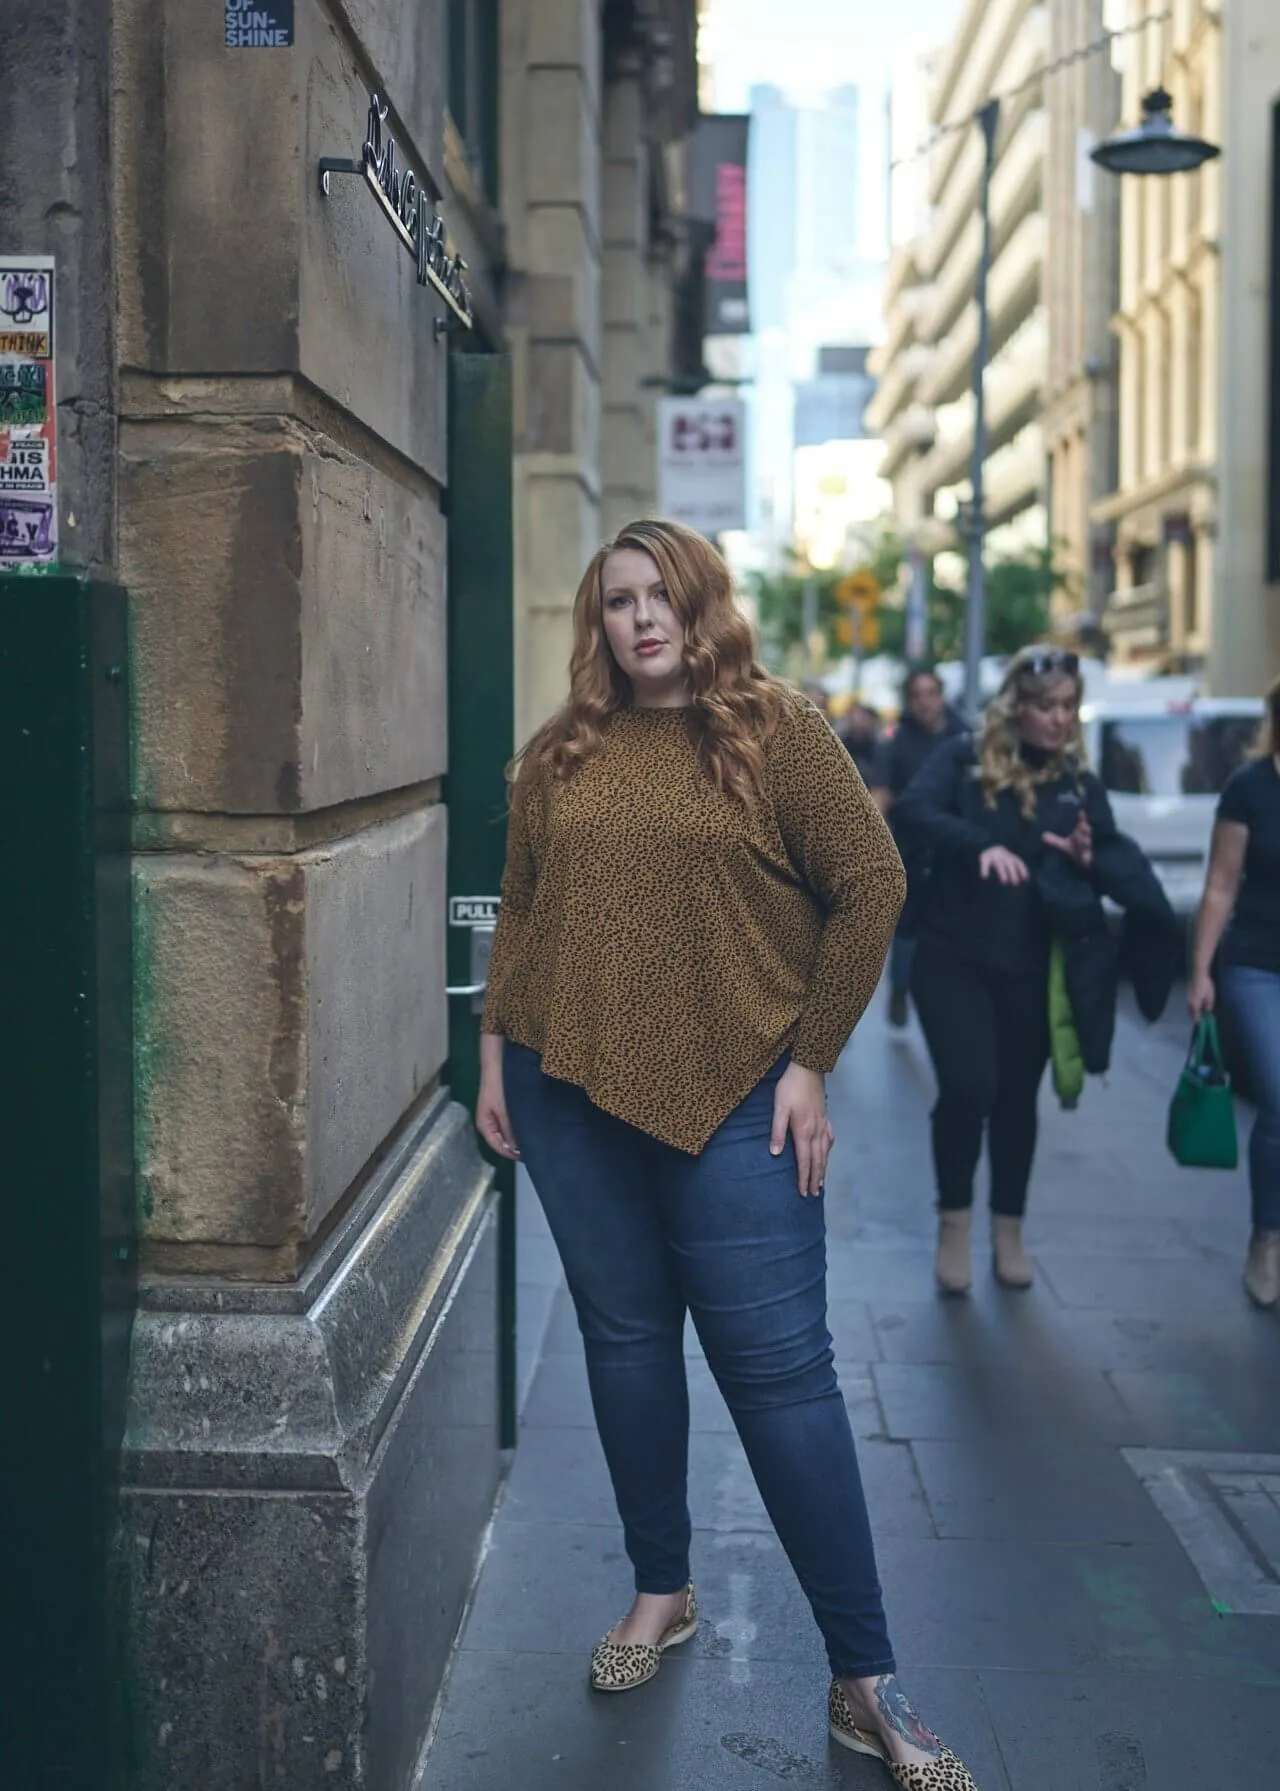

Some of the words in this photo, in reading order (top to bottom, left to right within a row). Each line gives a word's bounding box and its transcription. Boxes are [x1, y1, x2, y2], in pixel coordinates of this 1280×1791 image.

[226, 12, 277, 29] SUN-
[226, 30, 289, 46] SHINE
[457, 903, 497, 918] PULL
